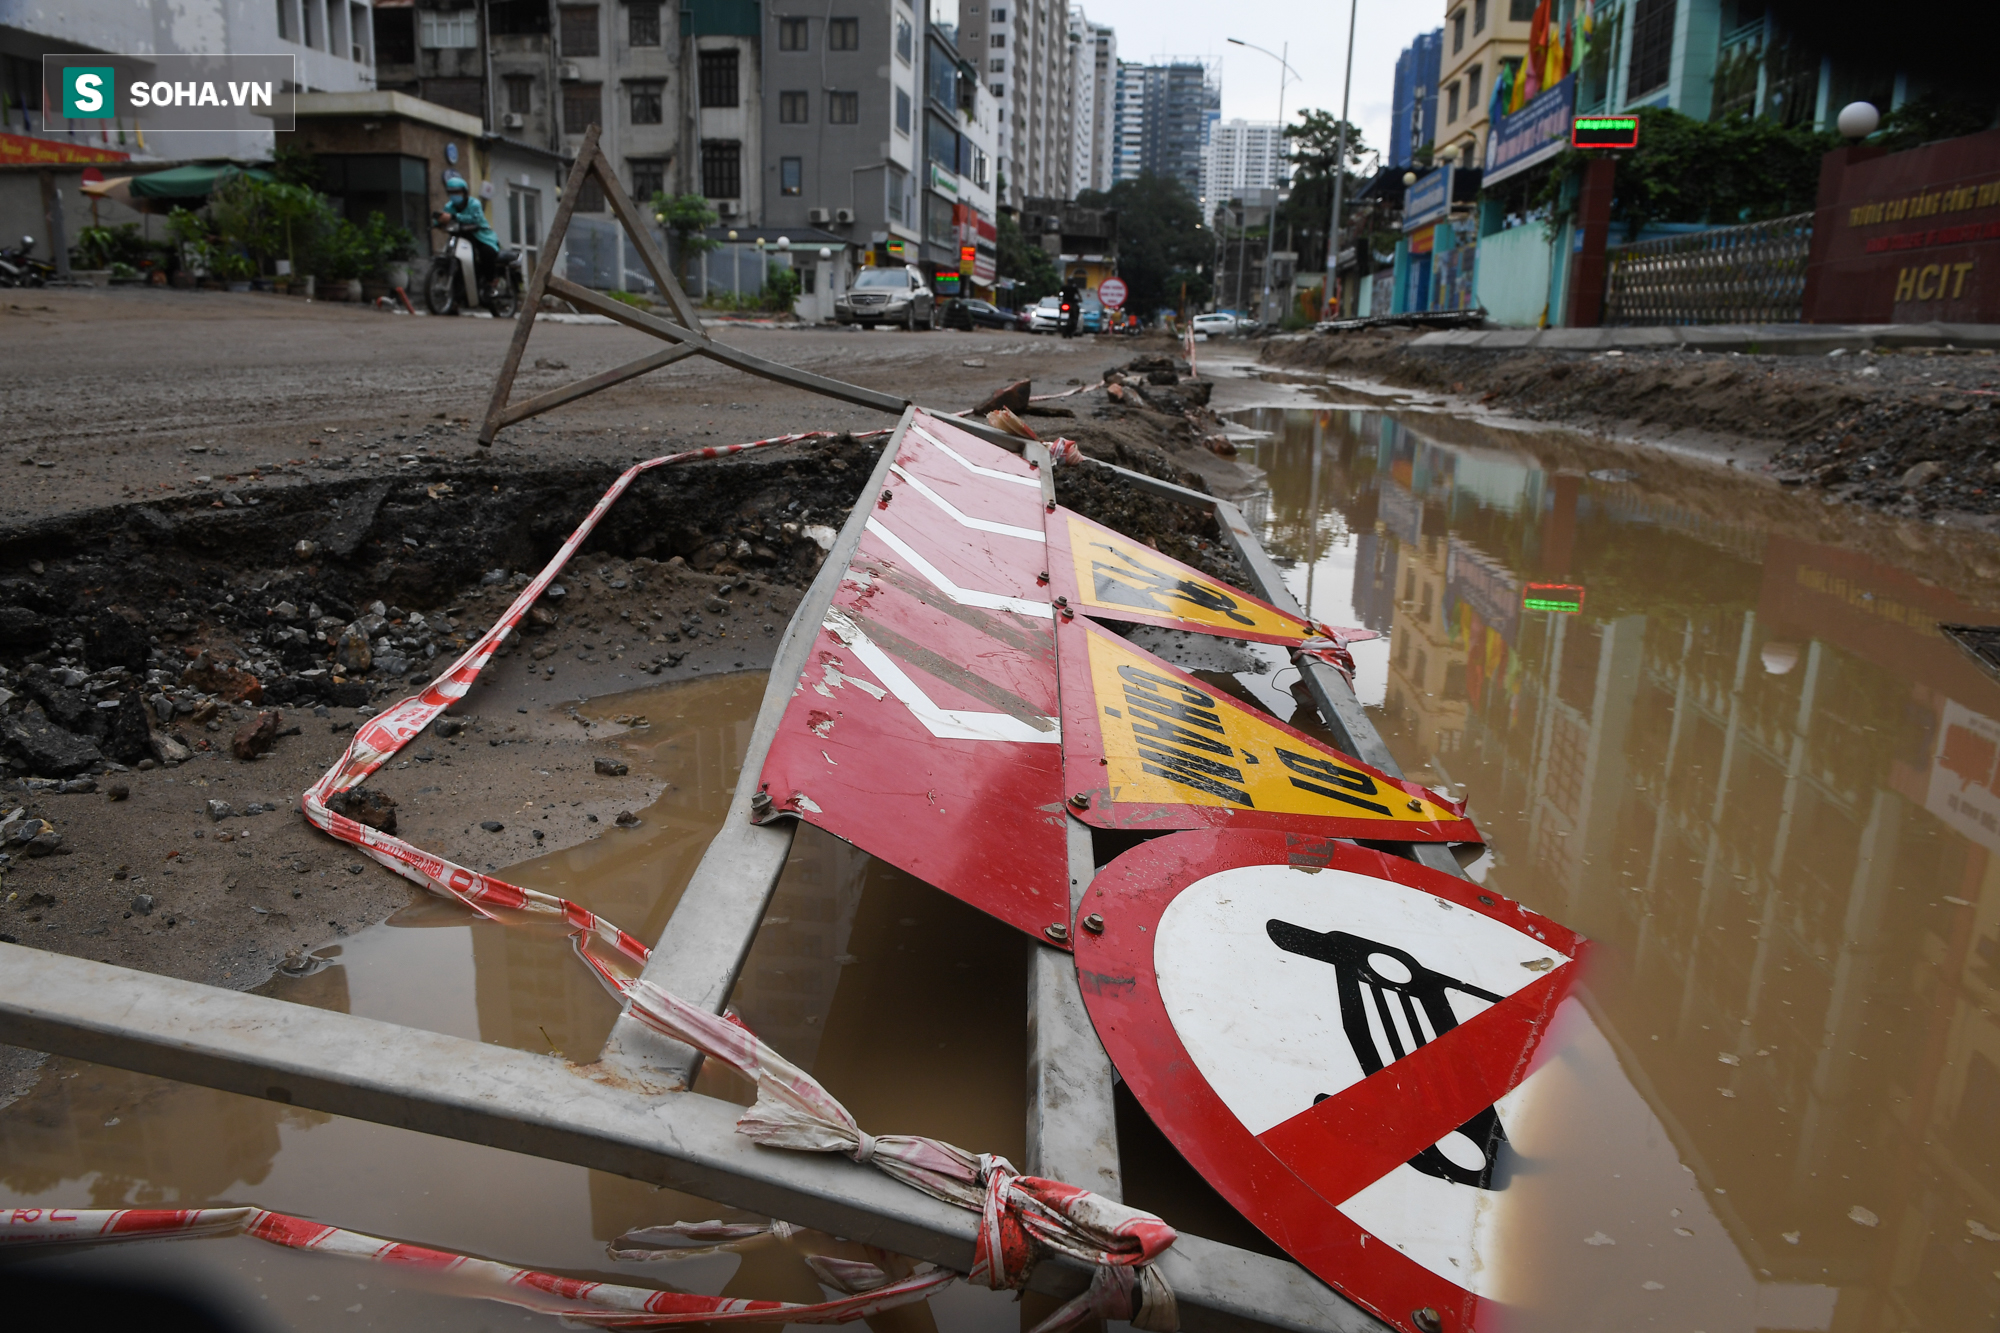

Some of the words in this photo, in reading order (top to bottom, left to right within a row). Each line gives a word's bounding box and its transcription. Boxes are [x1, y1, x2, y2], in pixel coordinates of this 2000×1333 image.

[1894, 262, 1974, 302] HCIT
[1104, 665, 1260, 809] CHẬM
[1274, 746, 1394, 817] ĐI
[422, 859, 444, 879] AREA
